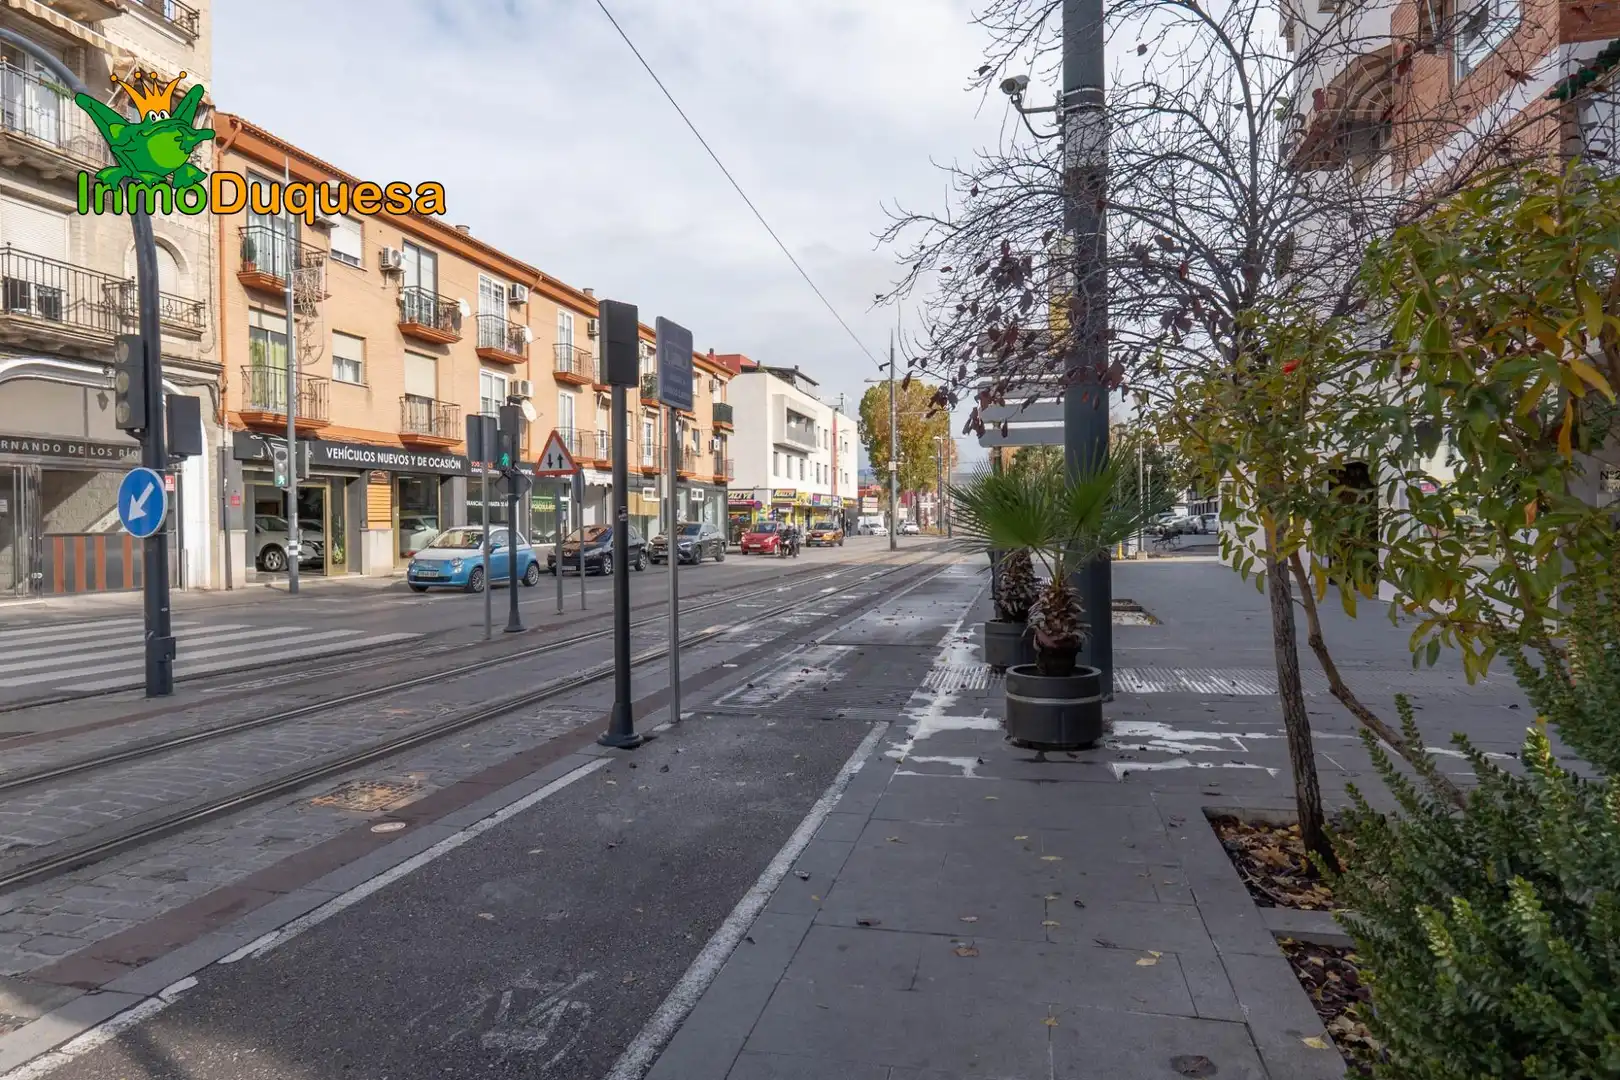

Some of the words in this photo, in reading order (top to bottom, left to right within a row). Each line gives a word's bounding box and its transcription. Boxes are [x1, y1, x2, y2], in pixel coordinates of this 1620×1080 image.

[1, 440, 61, 453] RNANDO
[69, 445, 84, 455] DE
[90, 447, 112, 457] LOS
[119, 447, 139, 457] RÍO
[326, 446, 376, 463] VEHÍCULOS
[377, 452, 409, 465] NUEVOS
[411, 455, 416, 466] Y
[417, 456, 428, 467] DE
[428, 457, 461, 469] OCASIÓN
